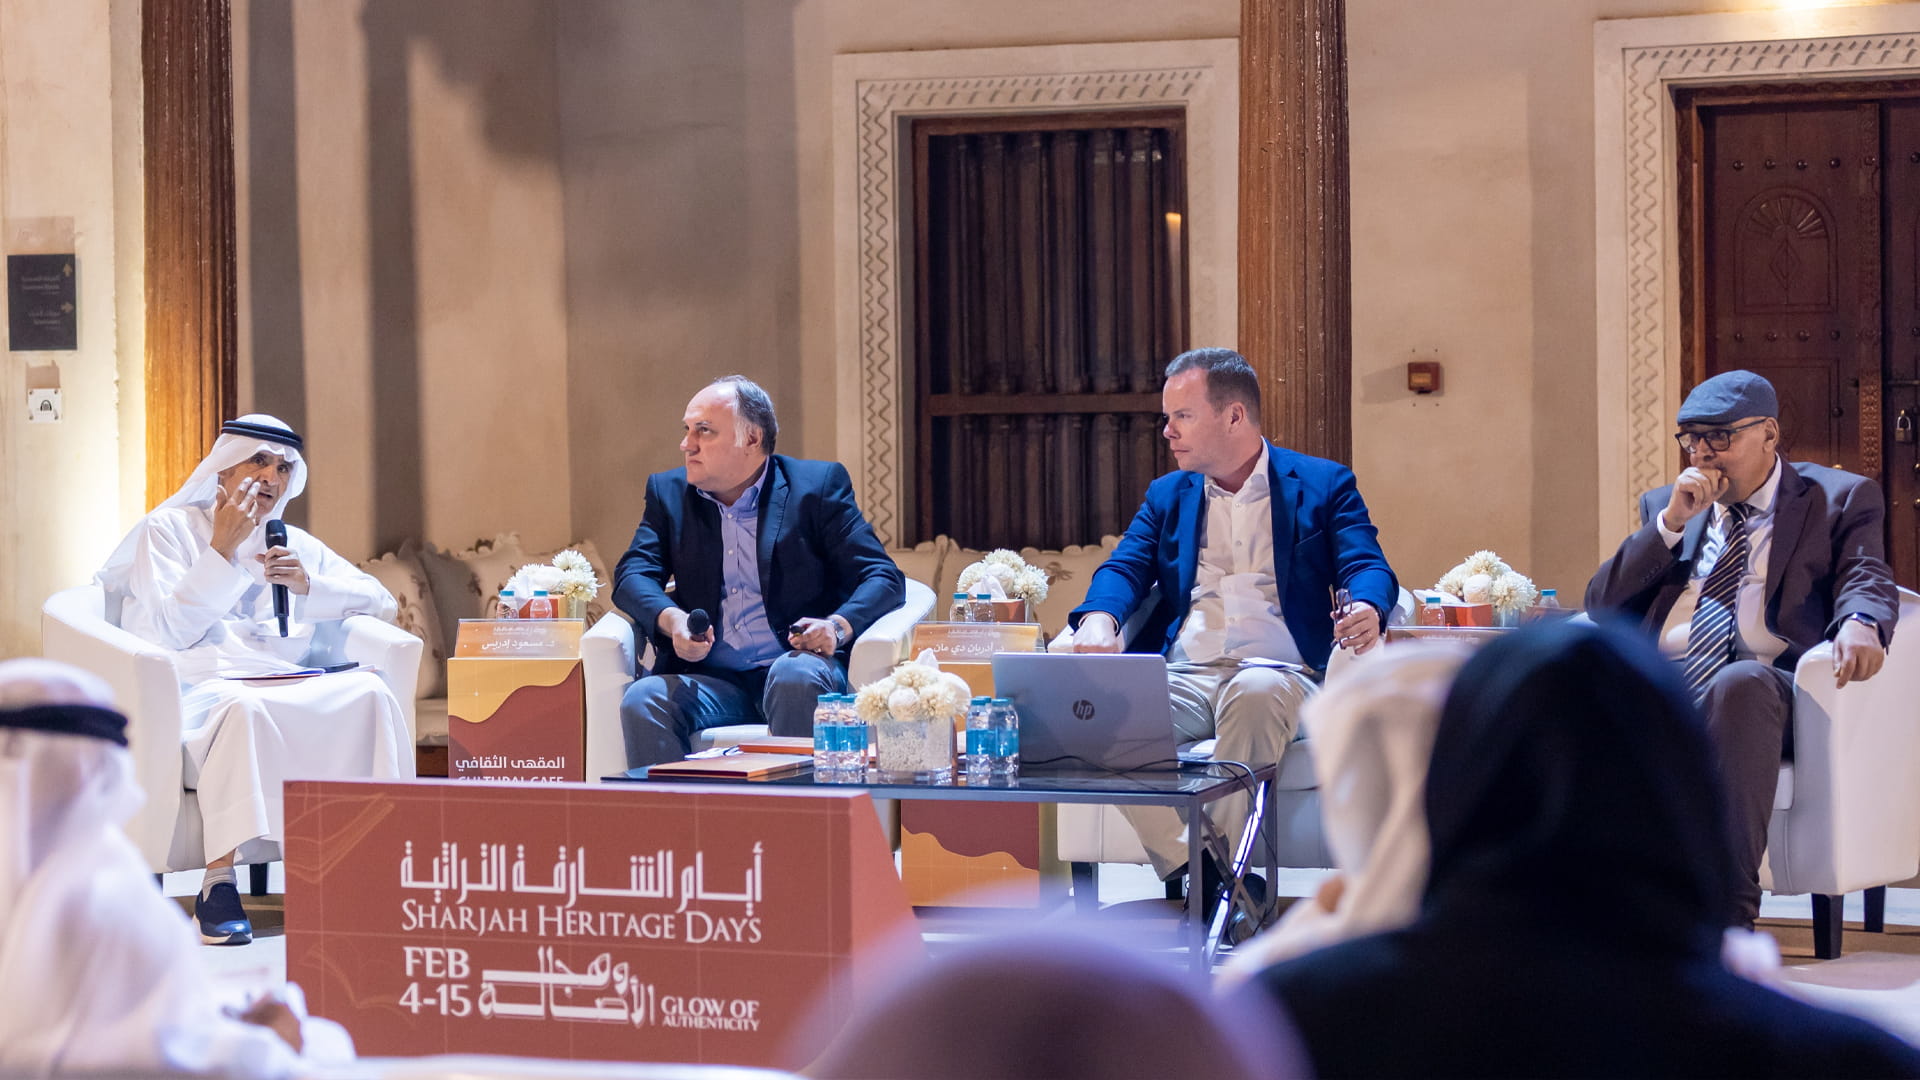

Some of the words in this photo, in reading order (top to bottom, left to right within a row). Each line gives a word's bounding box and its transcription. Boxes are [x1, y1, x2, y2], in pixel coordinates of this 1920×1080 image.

[511, 639, 543, 650] مسعود
[1074, 700, 1094, 720] hp
[455, 754, 507, 772] الثقافي
[511, 756, 565, 769] المقهى
[400, 840, 506, 905] التراثية
[512, 844, 674, 909] الشارقة
[675, 841, 764, 917] أيام
[401, 899, 528, 936] SHARJAH
[537, 904, 676, 939] HERITAGE
[685, 910, 762, 943] DAYS
[403, 946, 470, 979] FEB
[398, 982, 472, 1017] 4-15
[660, 995, 725, 1017] GLOW
[729, 999, 760, 1019] OF
[662, 1015, 760, 1031] AUTHENTICITY
